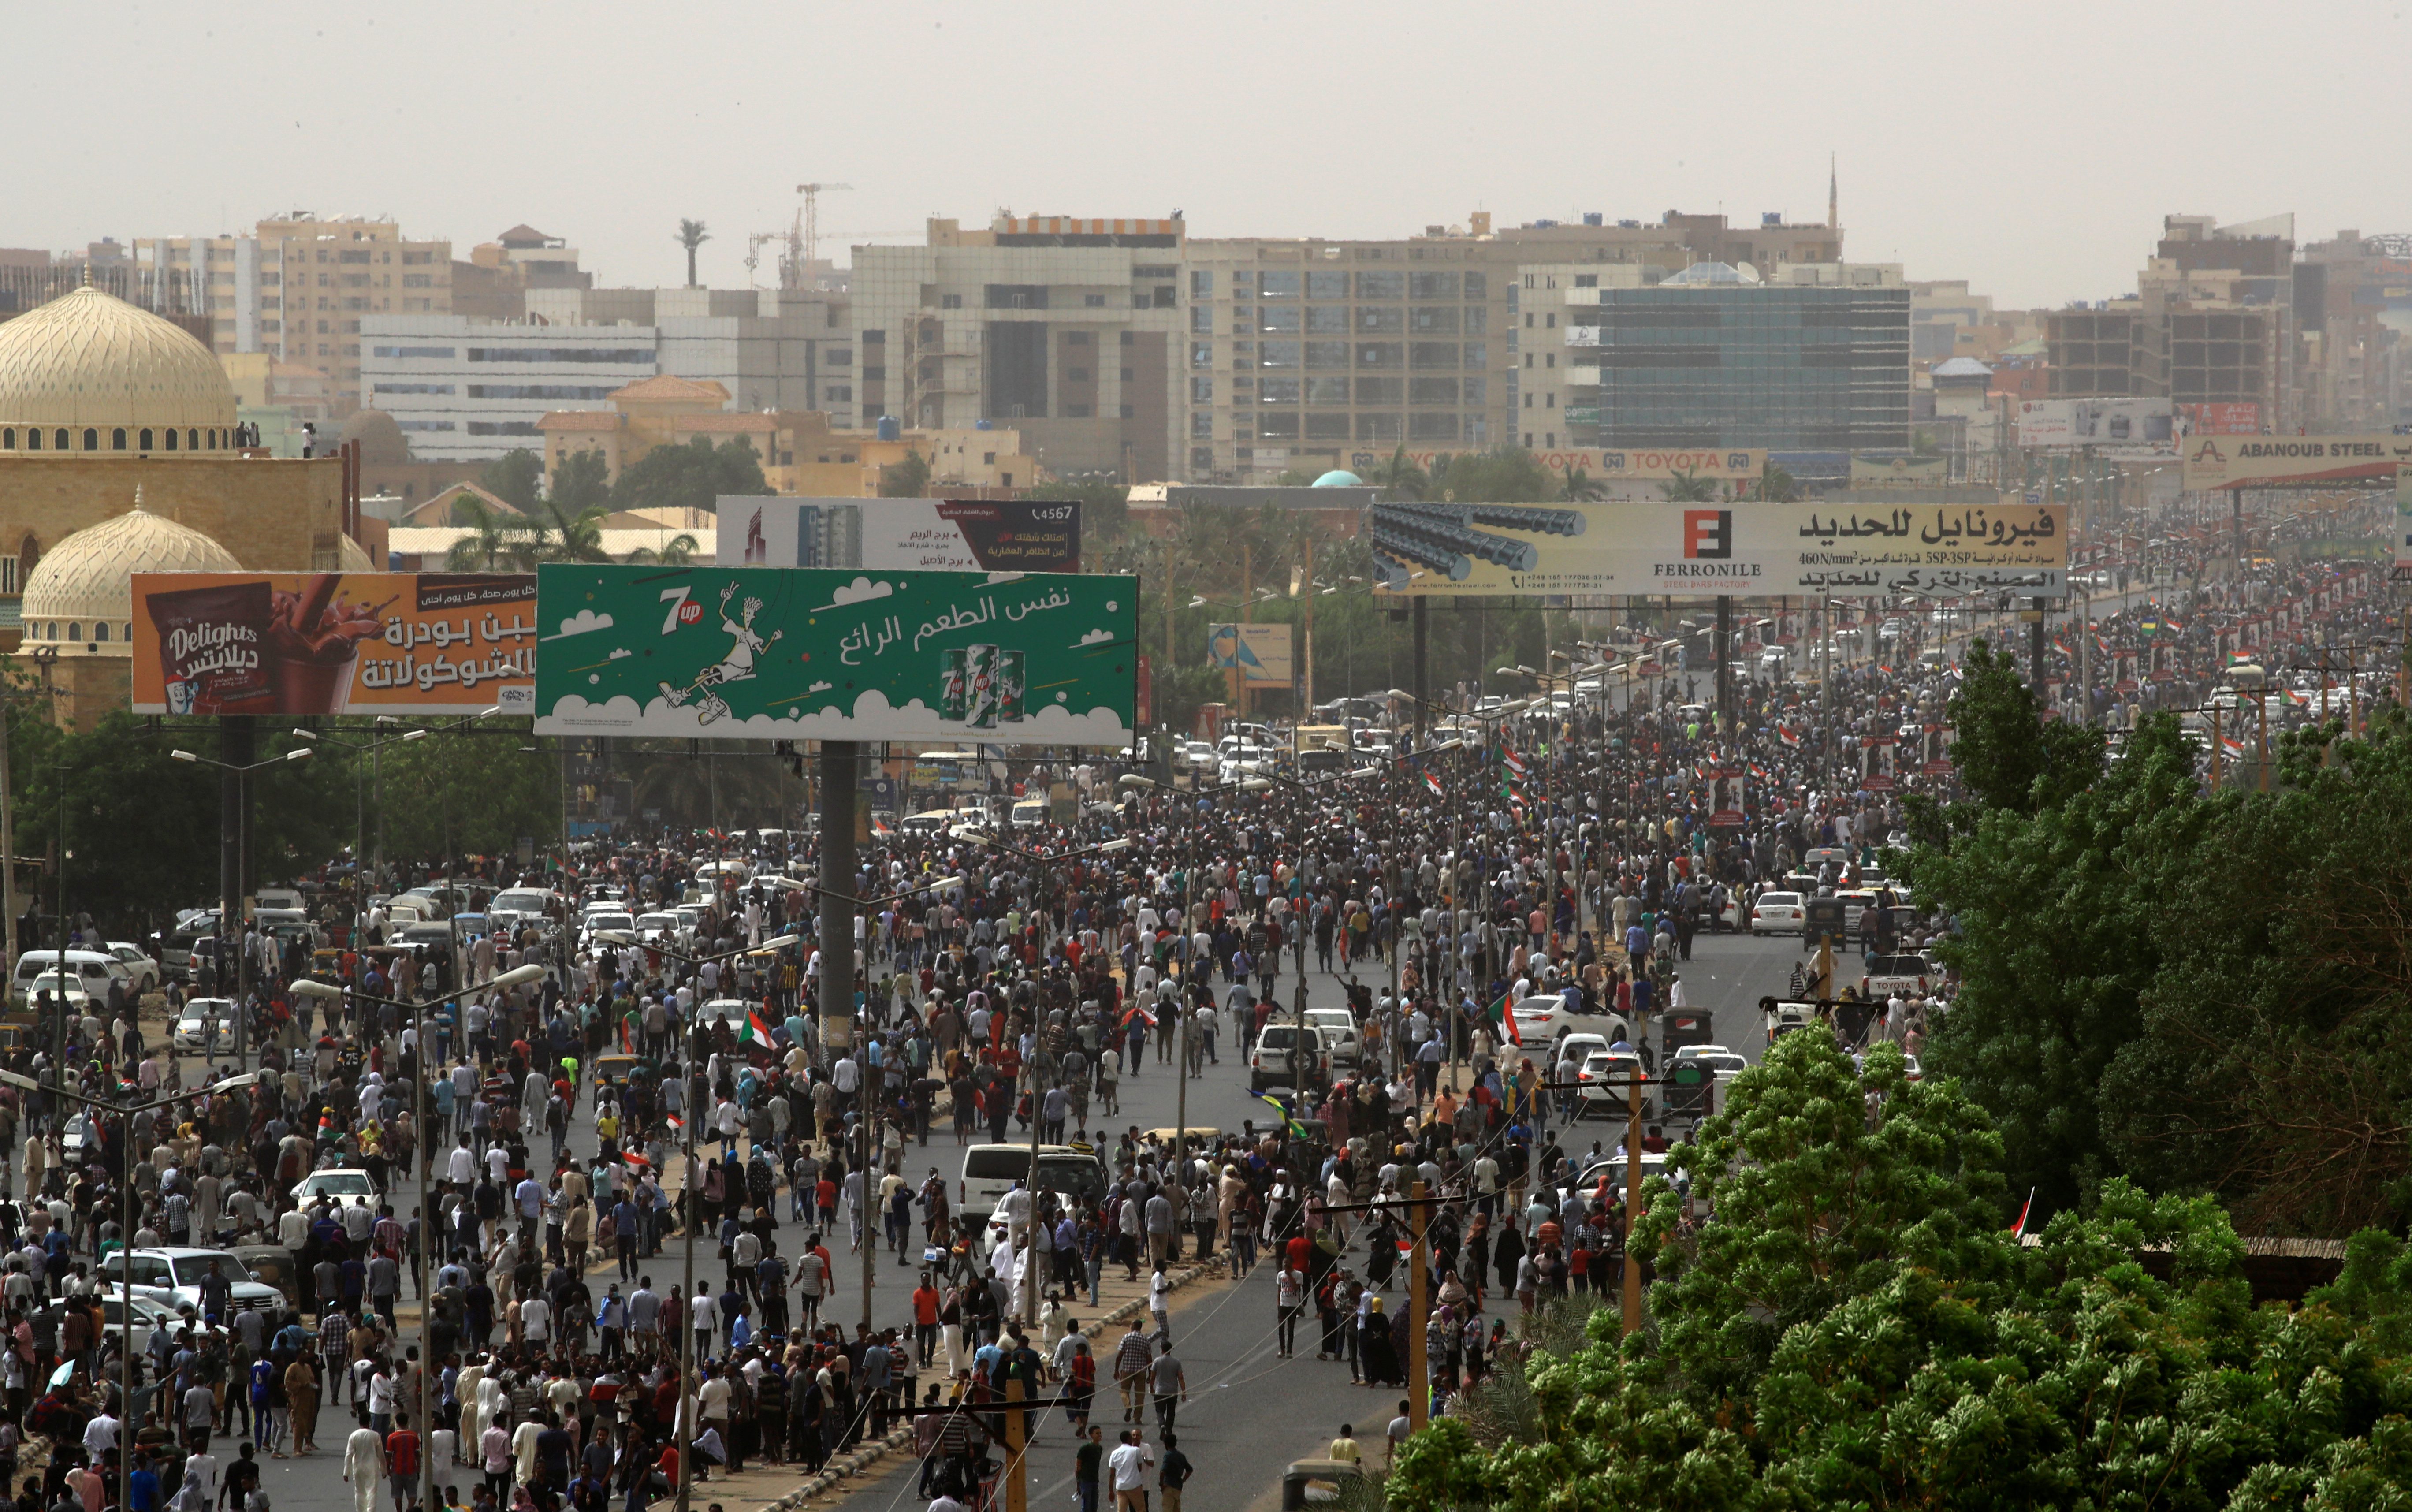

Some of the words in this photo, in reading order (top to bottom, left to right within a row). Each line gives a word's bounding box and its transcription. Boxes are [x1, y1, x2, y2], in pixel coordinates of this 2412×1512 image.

[2239, 444, 2324, 457] ABANOUB
[2330, 443, 2385, 457] STEEL
[1633, 453, 1720, 469] TOYOTA
[1041, 506, 1073, 519] 4567
[1799, 507, 1912, 547] للحديد
[1921, 508, 2055, 547] فيرونايل
[910, 529, 932, 540] الريم
[934, 531, 949, 540] برج
[1052, 548, 1065, 558] من
[2036, 554, 2055, 565] مواد
[920, 554, 946, 566] الأصيل
[948, 558, 963, 567] برج
[1859, 555, 1872, 566] من
[1653, 563, 1762, 577] FERRONILE
[1799, 570, 1881, 592] للحديد
[463, 591, 476, 601] كل
[502, 588, 520, 599] يوم
[522, 585, 535, 596] كل
[421, 593, 442, 606] أحلى
[443, 594, 462, 604] يوم
[1005, 587, 1071, 622] نفس
[914, 595, 997, 652] الطعم
[384, 616, 471, 650] بودرة
[169, 622, 257, 661] Delights
[839, 615, 902, 666] الرائع
[175, 644, 258, 679] ديلايتس
[361, 647, 536, 690] الشوكولاتة
[346, 1052, 358, 1065] 75
